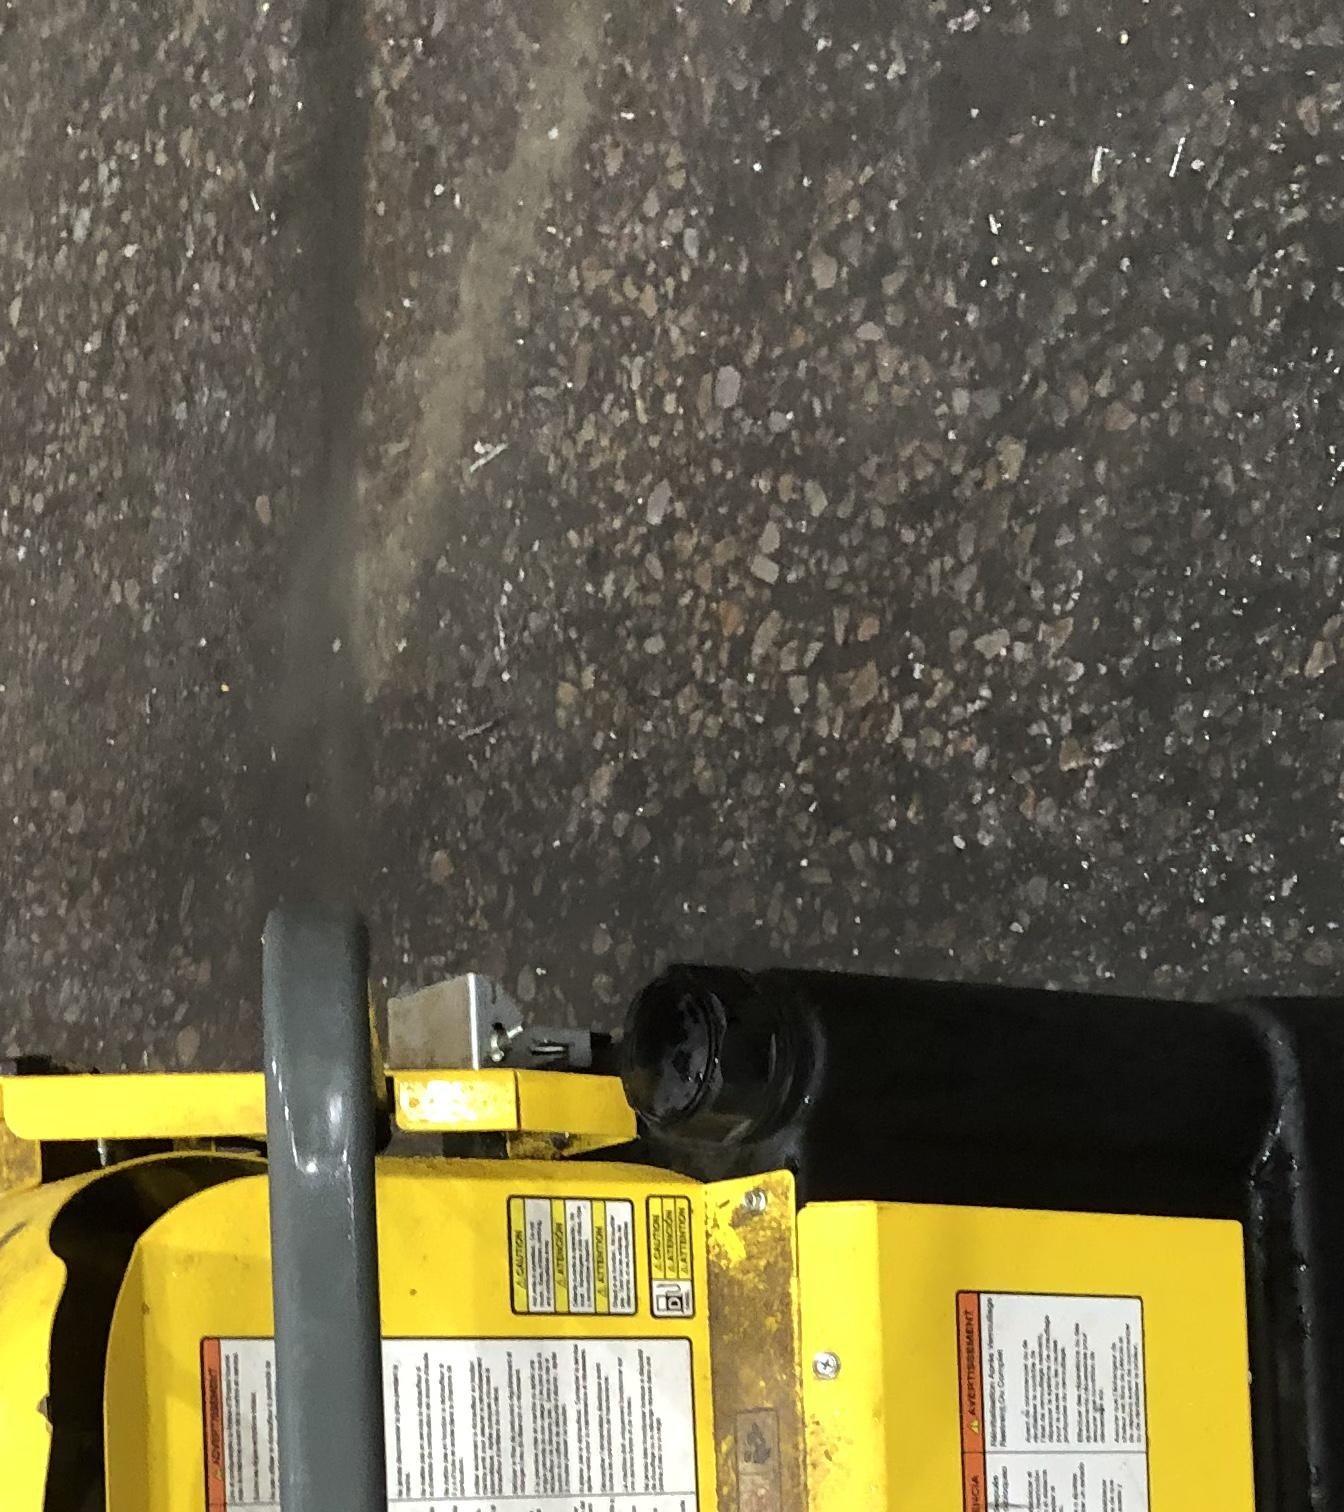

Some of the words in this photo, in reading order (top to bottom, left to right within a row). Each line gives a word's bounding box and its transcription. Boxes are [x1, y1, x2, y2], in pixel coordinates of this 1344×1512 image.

[514, 1230, 524, 1277] CAUTION
[553, 1222, 565, 1276] ATENCIÓN
[594, 1226, 605, 1284] ATTENTION
[651, 1215, 661, 1261] CAUTION
[663, 1210, 674, 1262] ATENCIÓN
[677, 1207, 687, 1264] ATTENTION
[964, 1309, 977, 1416] AVERTISSEMENT
